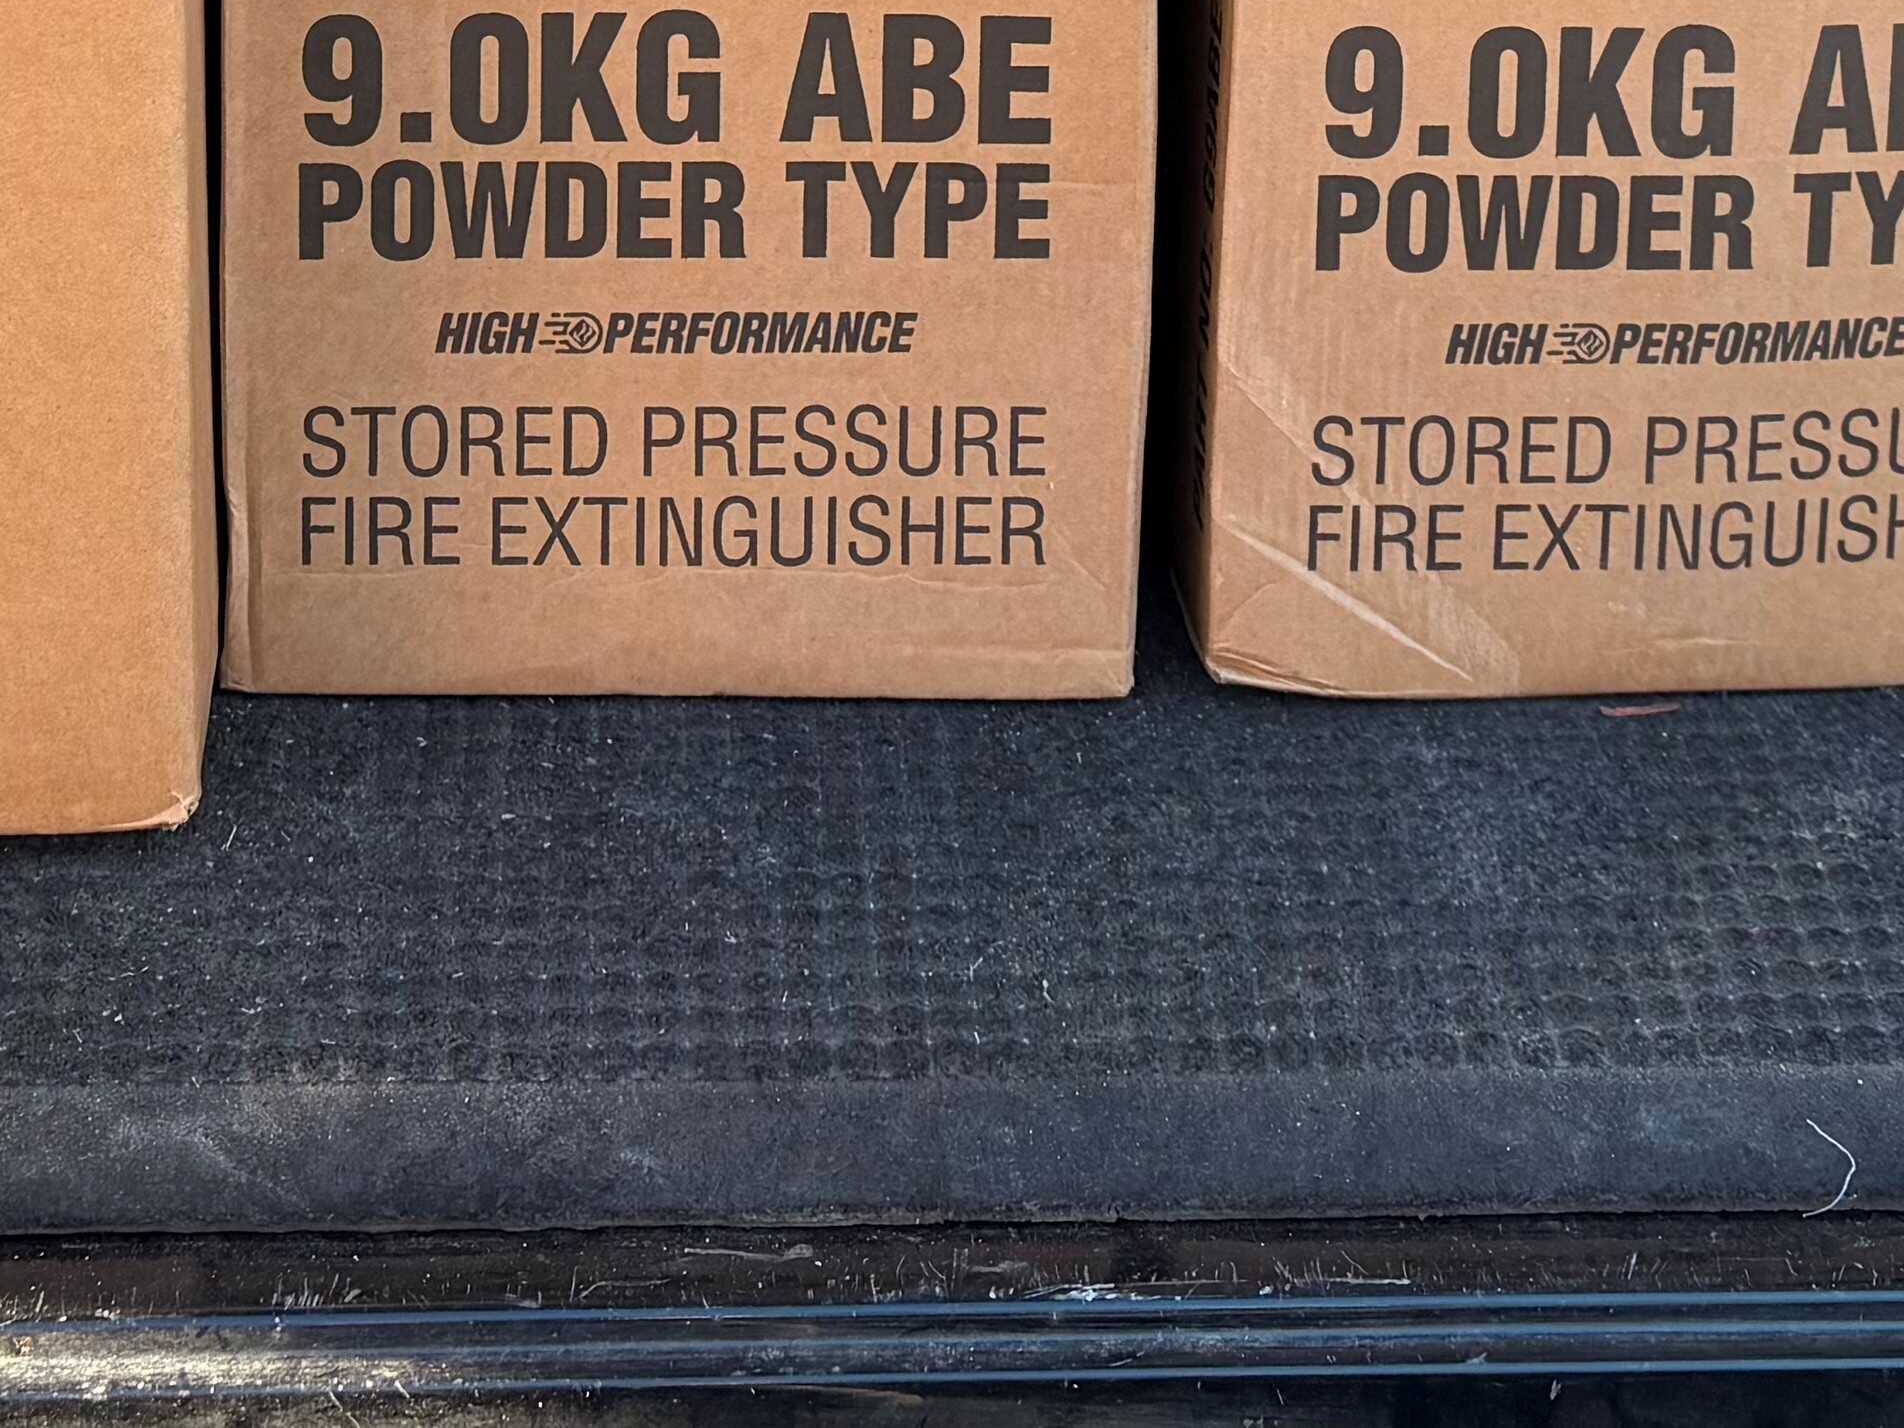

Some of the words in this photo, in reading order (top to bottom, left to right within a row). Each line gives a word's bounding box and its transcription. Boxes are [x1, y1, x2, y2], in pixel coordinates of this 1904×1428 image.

[302, 10, 720, 147] 9.0KG
[779, 12, 1052, 143] ABE
[1325, 24, 1735, 159] 9.0KG
[298, 159, 746, 261] POWDER
[786, 161, 1050, 259] TYPE
[1316, 172, 1754, 273] POWDER
[435, 311, 538, 354] HIGH
[602, 310, 919, 355] PERFORMANCE
[1445, 323, 1548, 365] HIGH
[302, 405, 608, 478] STORED
[643, 404, 1047, 478] PRESSURE
[1312, 415, 1612, 486] STORED
[302, 497, 463, 566] FIRE
[492, 495, 1048, 567] EXTINGUISHER
[1307, 504, 1463, 571] FIRE
